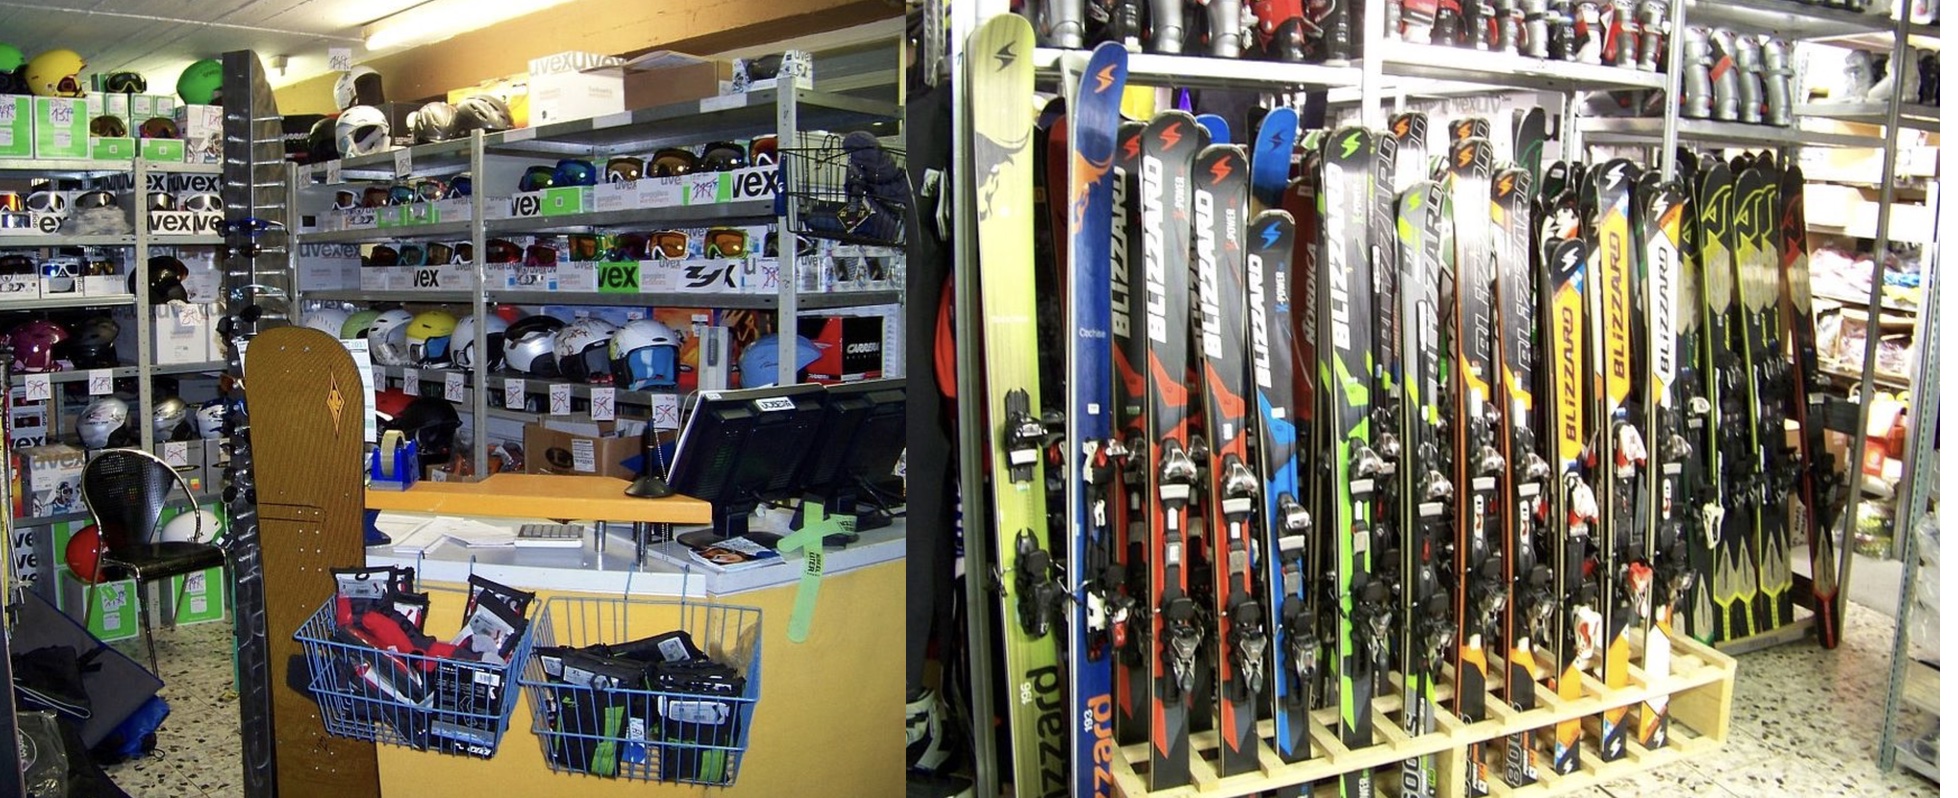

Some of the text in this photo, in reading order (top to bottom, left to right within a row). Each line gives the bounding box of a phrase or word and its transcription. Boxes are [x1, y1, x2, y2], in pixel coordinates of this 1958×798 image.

[1143, 155, 1167, 343] BLIZZARD
[1196, 189, 1222, 359] BLIZZARD
[1326, 162, 1350, 350] BLIZZARD
[1609, 231, 1626, 379] BLIZZARD
[1658, 247, 1670, 375] BLIZZARD
[1248, 254, 1271, 388] BLIZZARD
[1562, 306, 1577, 442] BLIZZARD
[1020, 681, 1032, 705] 196
[1084, 708, 1093, 732] 193
